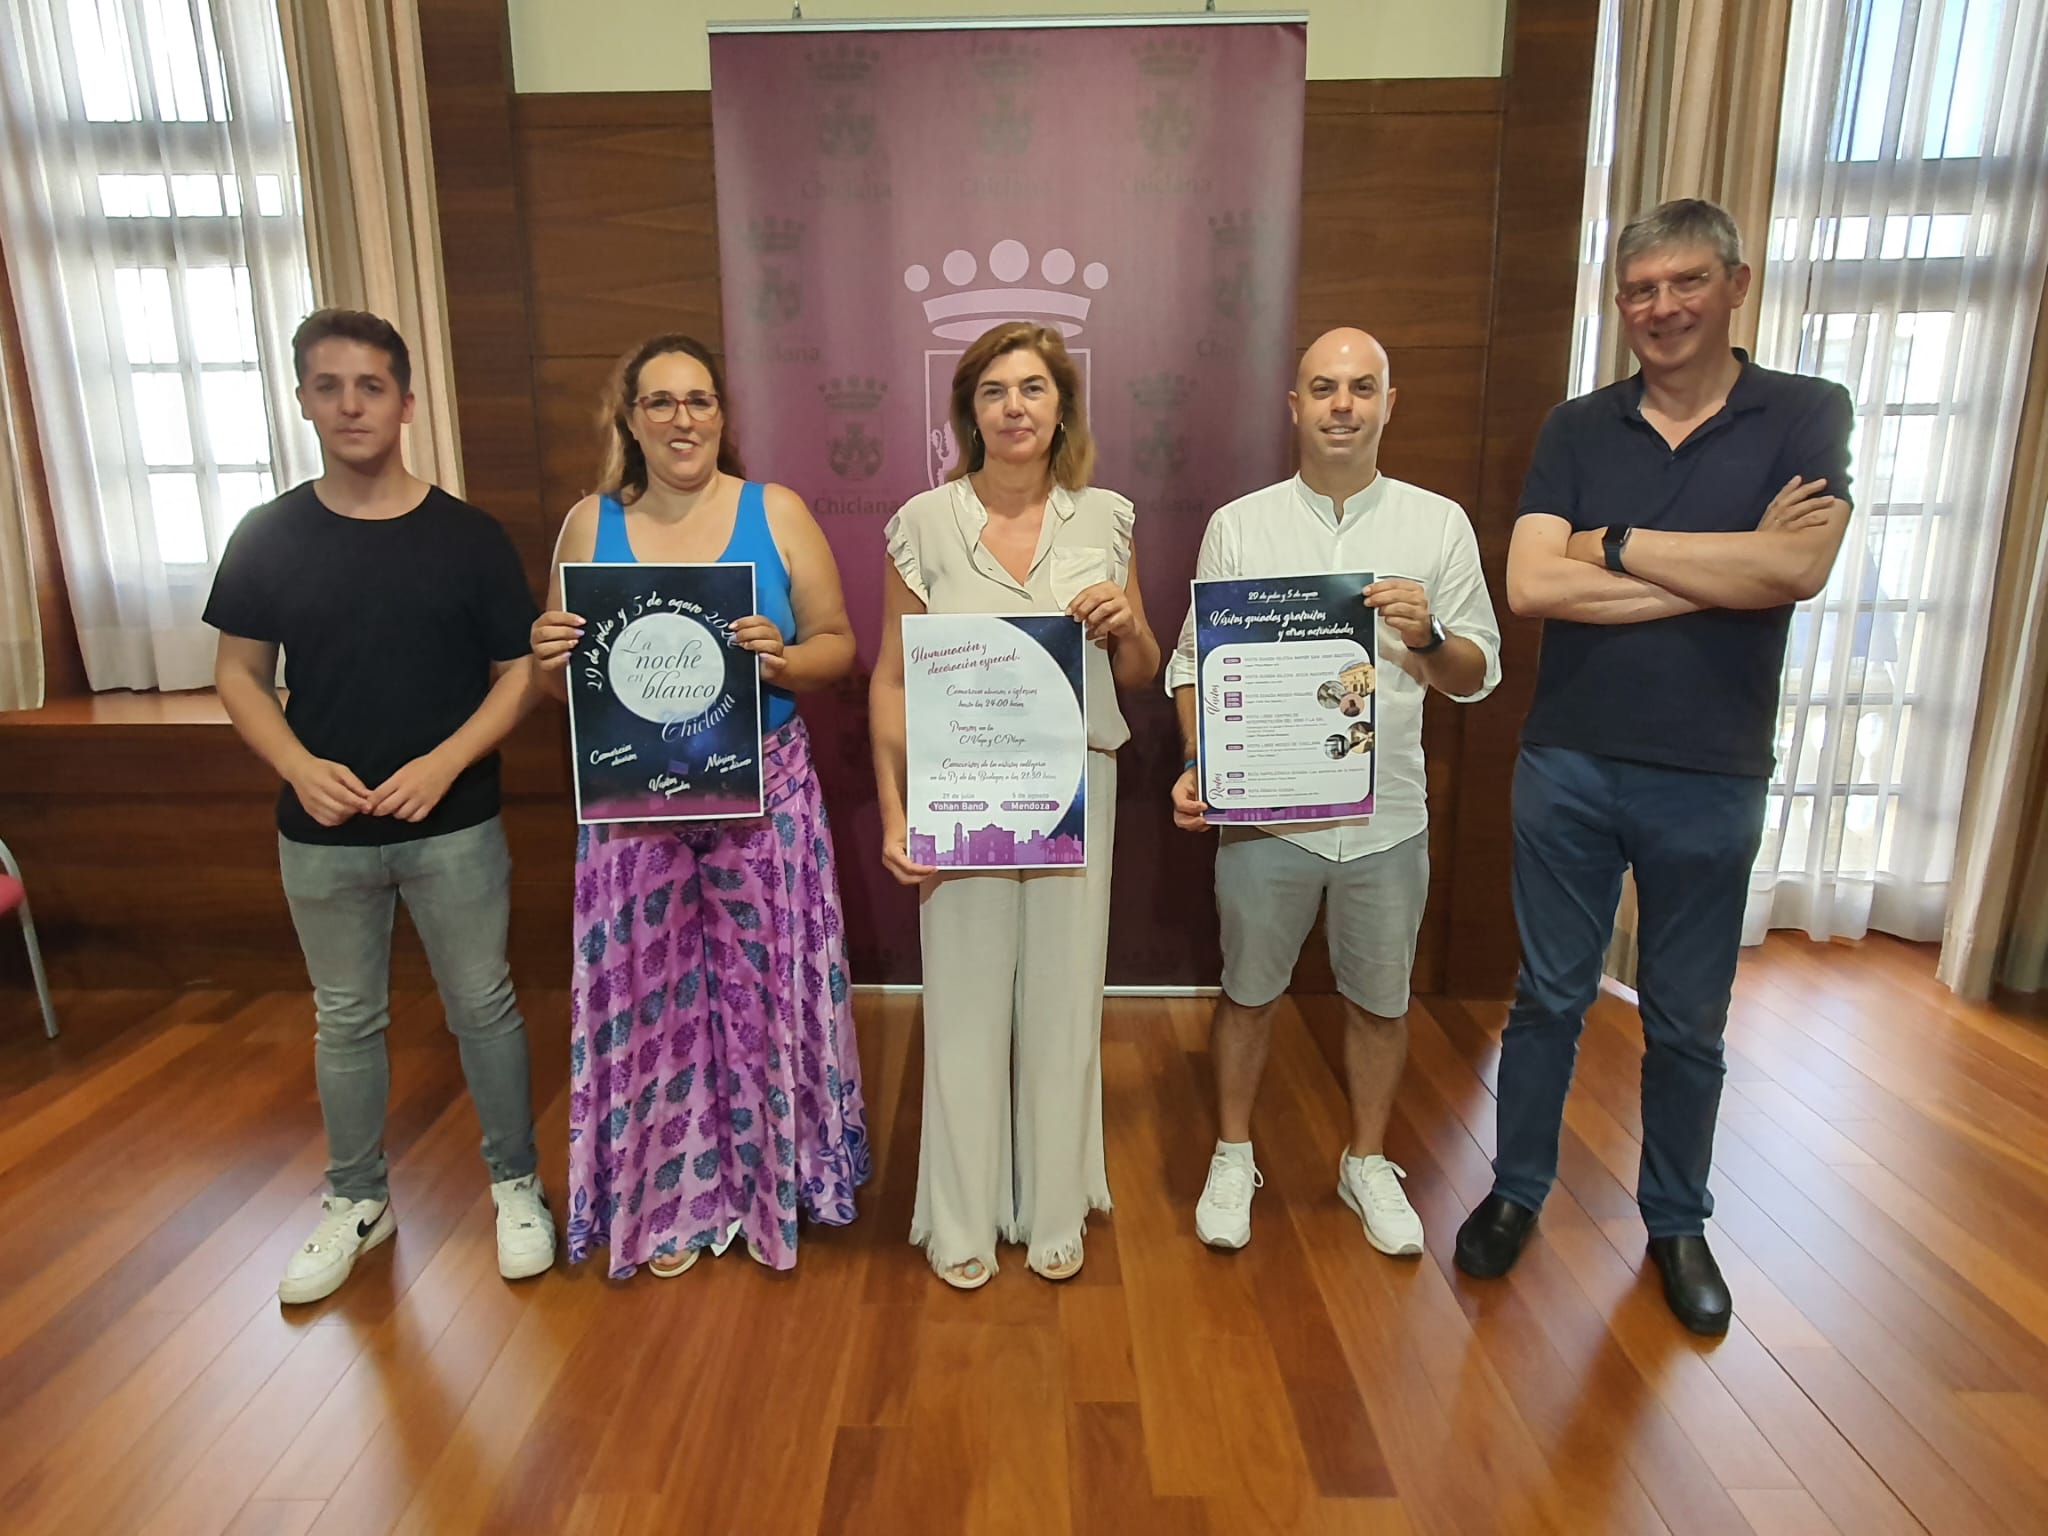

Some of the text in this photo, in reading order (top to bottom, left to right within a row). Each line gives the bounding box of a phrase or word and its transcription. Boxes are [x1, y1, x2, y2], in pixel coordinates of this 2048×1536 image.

[801, 177, 893, 199] Chiclana
[959, 175, 1051, 197] Chiclana
[633, 595, 643, 616] 5
[646, 591, 663, 607] de
[668, 598, 703, 614] agosto
[617, 608, 628, 630] y
[1209, 608, 1327, 629] Visitas guiadas gratuitas
[592, 619, 614, 652] julio
[621, 630, 651, 654] La
[1278, 622, 1354, 643] y otras actividades
[584, 648, 600, 665] de
[635, 640, 702, 670] noche
[911, 641, 987, 664] Iluminación y
[627, 672, 644, 683] en
[927, 659, 977, 675] decoración
[585, 670, 604, 690] 29
[641, 670, 716, 699] blanco
[661, 693, 736, 743] Chiclana
[933, 802, 984, 810] Yohan Band
[1011, 802, 1050, 810] Mendoza
